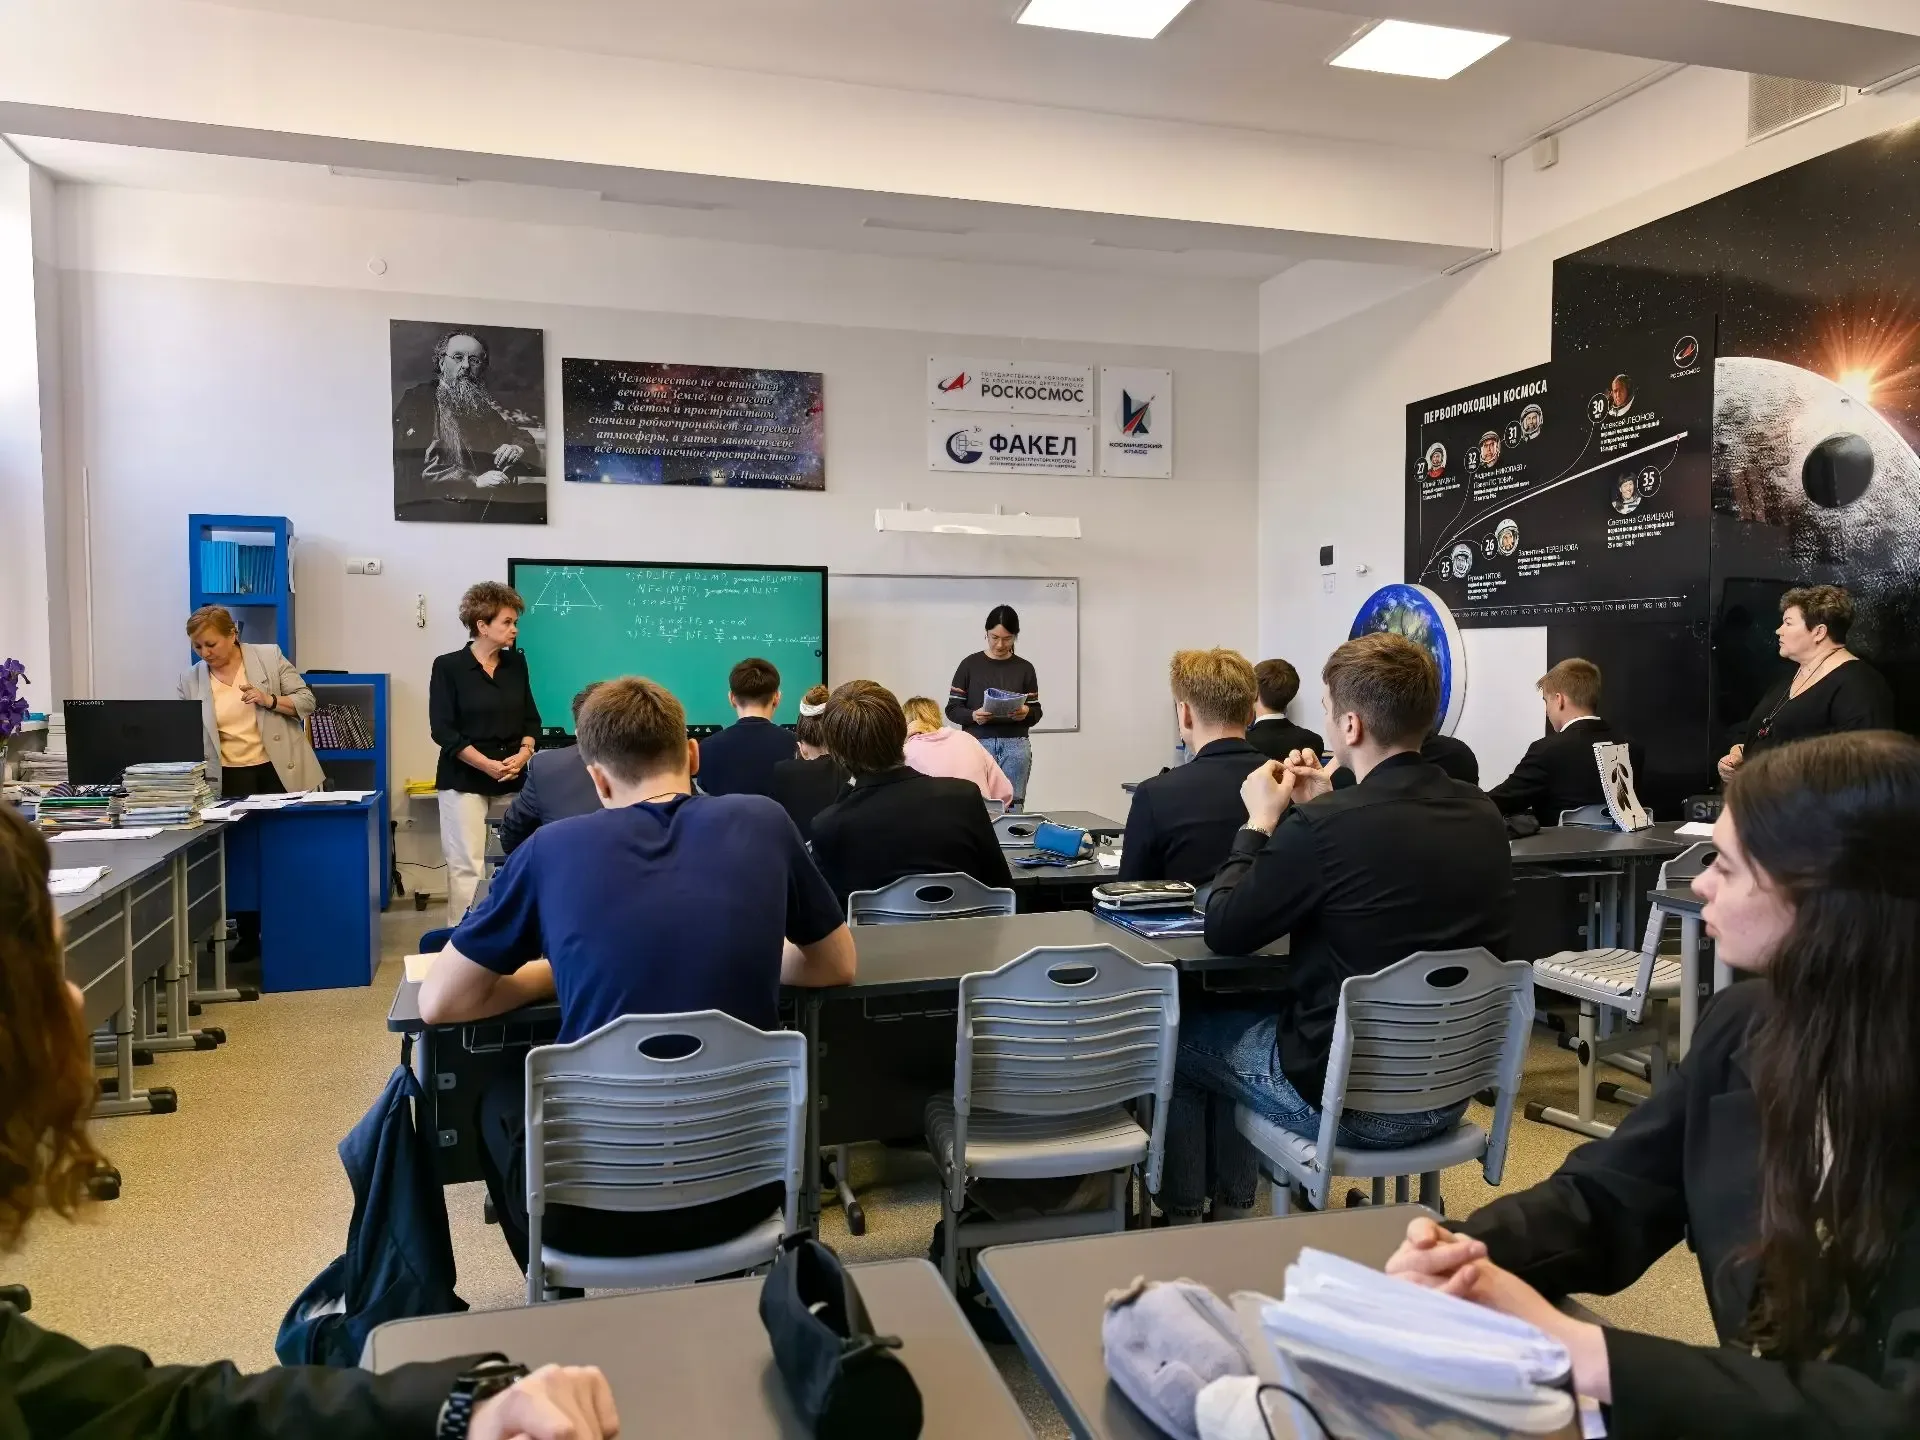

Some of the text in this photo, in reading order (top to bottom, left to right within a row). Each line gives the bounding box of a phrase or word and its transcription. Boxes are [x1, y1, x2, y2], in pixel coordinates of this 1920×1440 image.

[611, 372, 780, 391] «Человечество не останется
[617, 389, 650, 398] вечно
[672, 389, 707, 402] Земле,
[710, 394, 724, 402] но
[735, 395, 774, 405] погоне
[981, 384, 1084, 402] РОСКОСМОС
[1424, 379, 1548, 424] ПЕРВОПРОХОДЦЫ КОСМОСА
[1592, 399, 1604, 414] 30
[612, 402, 778, 420] за светом и пространством,
[1626, 411, 1655, 424] ЛЕОНОВ
[588, 416, 801, 435] сначала робко проникнет за пределы
[1508, 426, 1517, 440] 31
[596, 430, 794, 448] атмосферы, а затем завоюет себе
[989, 433, 1076, 456] ФАКЕЛ
[594, 444, 797, 462] всё околосолнечное пространство»
[1468, 452, 1477, 464] 32
[714, 469, 802, 481] К. Э. Циолковский
[1417, 462, 1425, 474] 27
[1642, 471, 1655, 487] 35
[1637, 510, 1674, 522] САВИЦКАЯ
[1485, 539, 1495, 551] 26
[1441, 561, 1450, 573] 25
